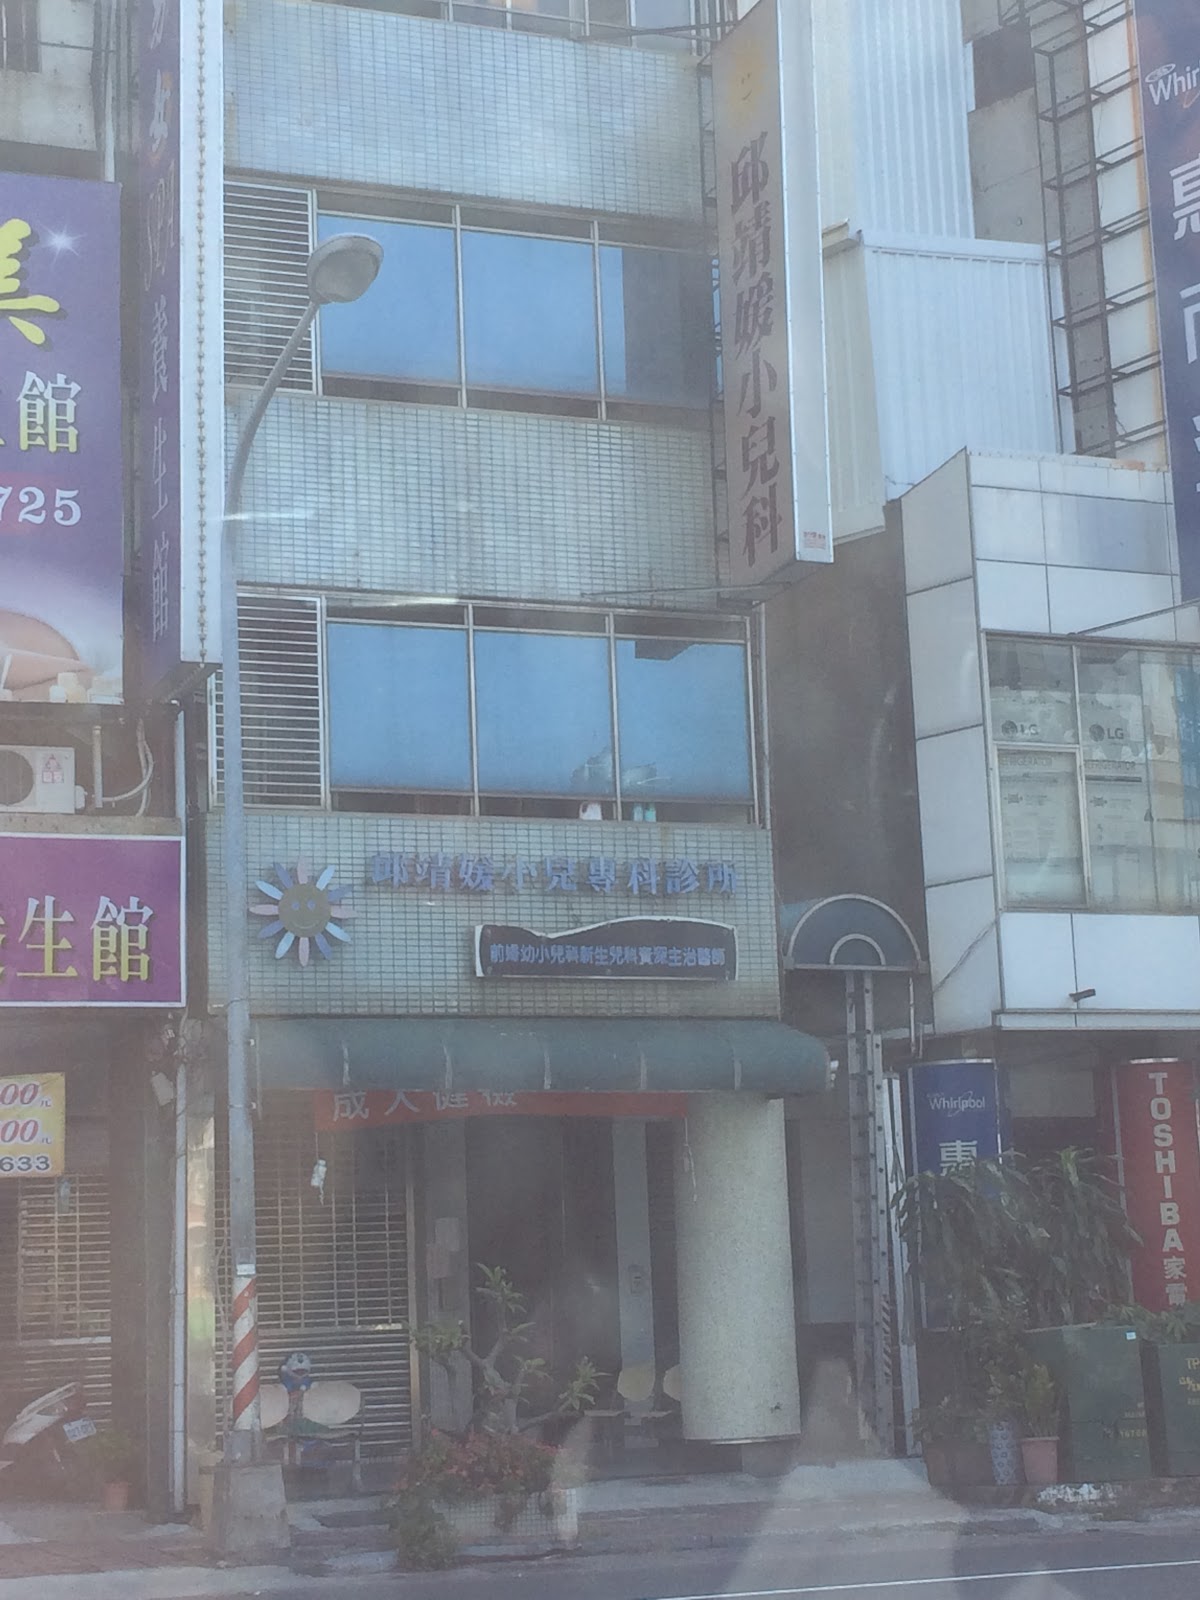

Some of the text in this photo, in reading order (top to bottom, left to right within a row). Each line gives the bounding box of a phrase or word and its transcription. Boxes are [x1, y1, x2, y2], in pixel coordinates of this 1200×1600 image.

[0, 371, 82, 453] 館
[1107, 728, 1124, 740] LG
[0, 895, 154, 982] 生館
[928, 1096, 986, 1111] Whirlpool
[0, 1155, 51, 1172] 633
[1149, 1072, 1184, 1252] TOSHIBA
